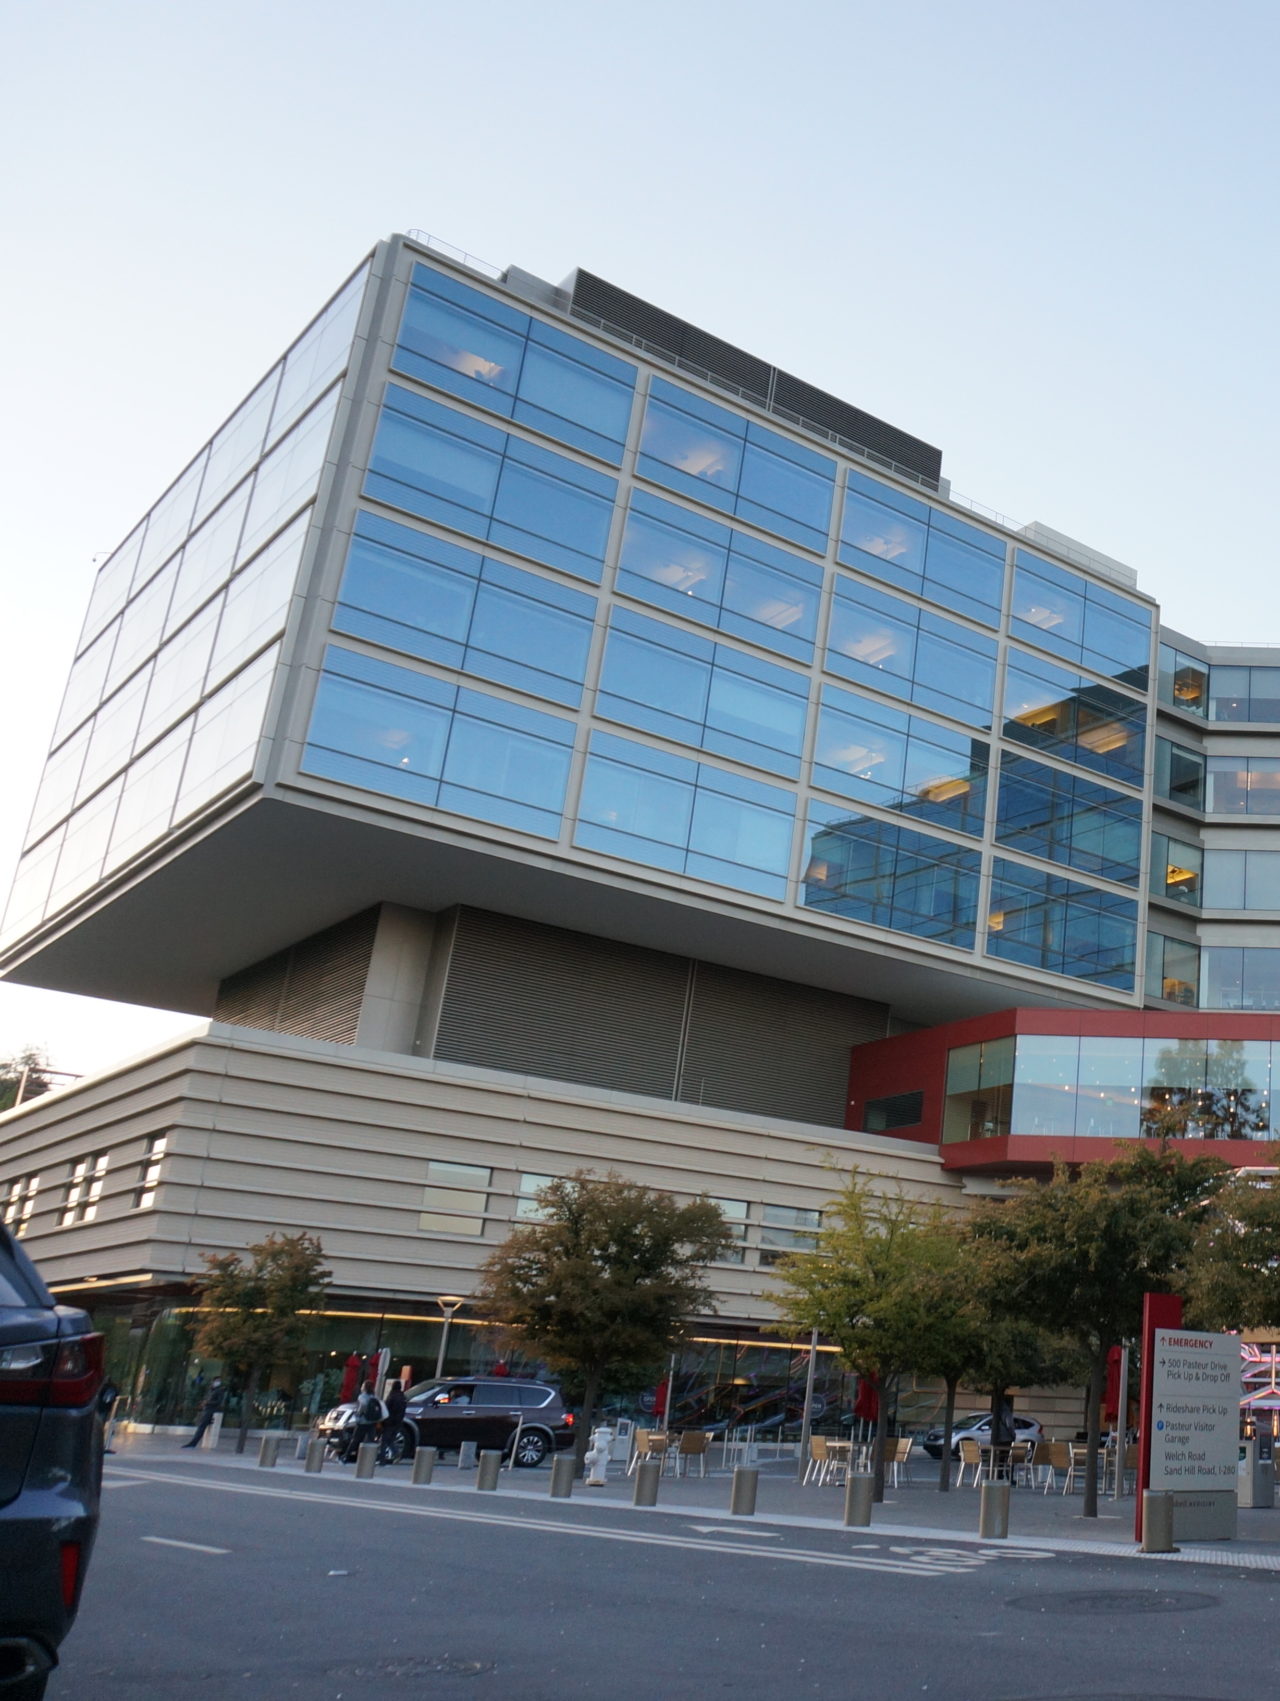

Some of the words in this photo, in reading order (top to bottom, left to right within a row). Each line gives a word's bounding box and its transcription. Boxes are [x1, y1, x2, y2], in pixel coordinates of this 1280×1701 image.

[1168, 1337, 1214, 1349] EMERGENCY
[1168, 1358, 1181, 1368] 500
[1183, 1359, 1209, 1370] Pasteur
[1211, 1361, 1228, 1371] Drive
[1167, 1370, 1182, 1379] Pick
[1184, 1371, 1194, 1382] Up
[1202, 1373, 1219, 1383] Drop
[1220, 1373, 1231, 1382] Off
[1166, 1403, 1200, 1414] Rideshare
[1203, 1405, 1216, 1414] Pick
[1218, 1406, 1228, 1416] Up
[1166, 1421, 1192, 1431] Pasteur
[1194, 1422, 1215, 1432] Visitor
[1165, 1434, 1190, 1444] Garage
[1165, 1451, 1187, 1461] Welch
[1188, 1451, 1206, 1461] Road
[1164, 1466, 1183, 1475] Sand
[1184, 1466, 1196, 1475] Hill
[1198, 1466, 1217, 1476] Road,
[1219, 1466, 1236, 1475] I-280
